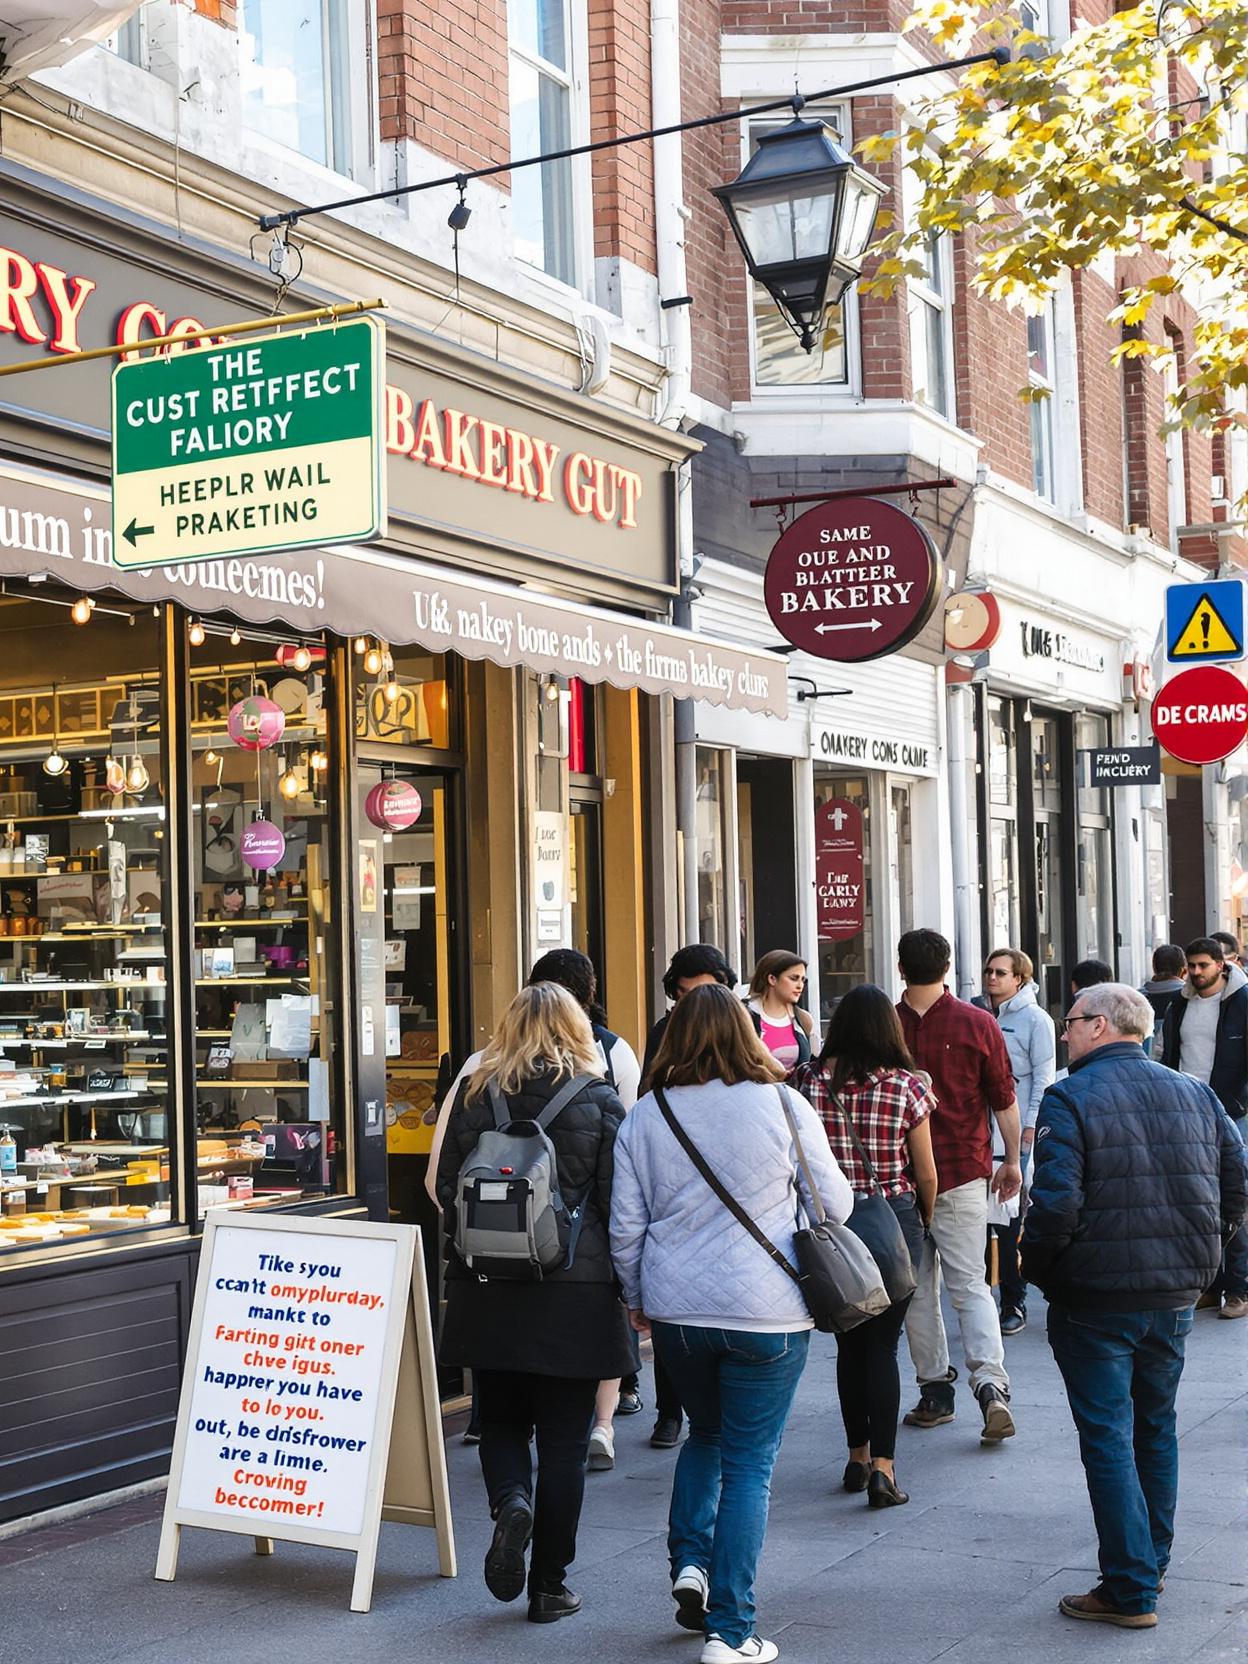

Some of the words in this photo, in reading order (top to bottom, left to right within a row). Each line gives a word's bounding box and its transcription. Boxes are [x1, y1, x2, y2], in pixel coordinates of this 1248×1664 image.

[208, 349, 263, 381] THE
[126, 391, 200, 427] CUST
[212, 363, 360, 414] RETFFECT
[170, 412, 293, 456] FALIORY
[385, 384, 560, 502] BAKERY
[563, 452, 642, 529] GUT
[160, 473, 254, 507] HEEPLR
[264, 463, 331, 492] WAIL
[176, 498, 318, 537] PRAKETING
[820, 526, 872, 544] SAME
[798, 550, 840, 567] OUE
[846, 545, 891, 563] AND
[796, 565, 897, 586] BLATTEER
[781, 582, 915, 613] BAKERY
[517, 612, 560, 657] bone
[563, 624, 601, 667] ands
[1157, 705, 1182, 725] DE
[1184, 703, 1248, 724] CRAMS
[259, 1254, 294, 1273] Tike
[312, 1312, 331, 1326] to
[320, 1340, 365, 1356] oner
[277, 1381, 311, 1396] you
[316, 1380, 363, 1401] have
[241, 1398, 260, 1413] to
[284, 1406, 324, 1421] you.
[195, 1418, 232, 1439] out,
[238, 1421, 260, 1438] be
[219, 1446, 251, 1462] are
[257, 1452, 268, 1464] a
